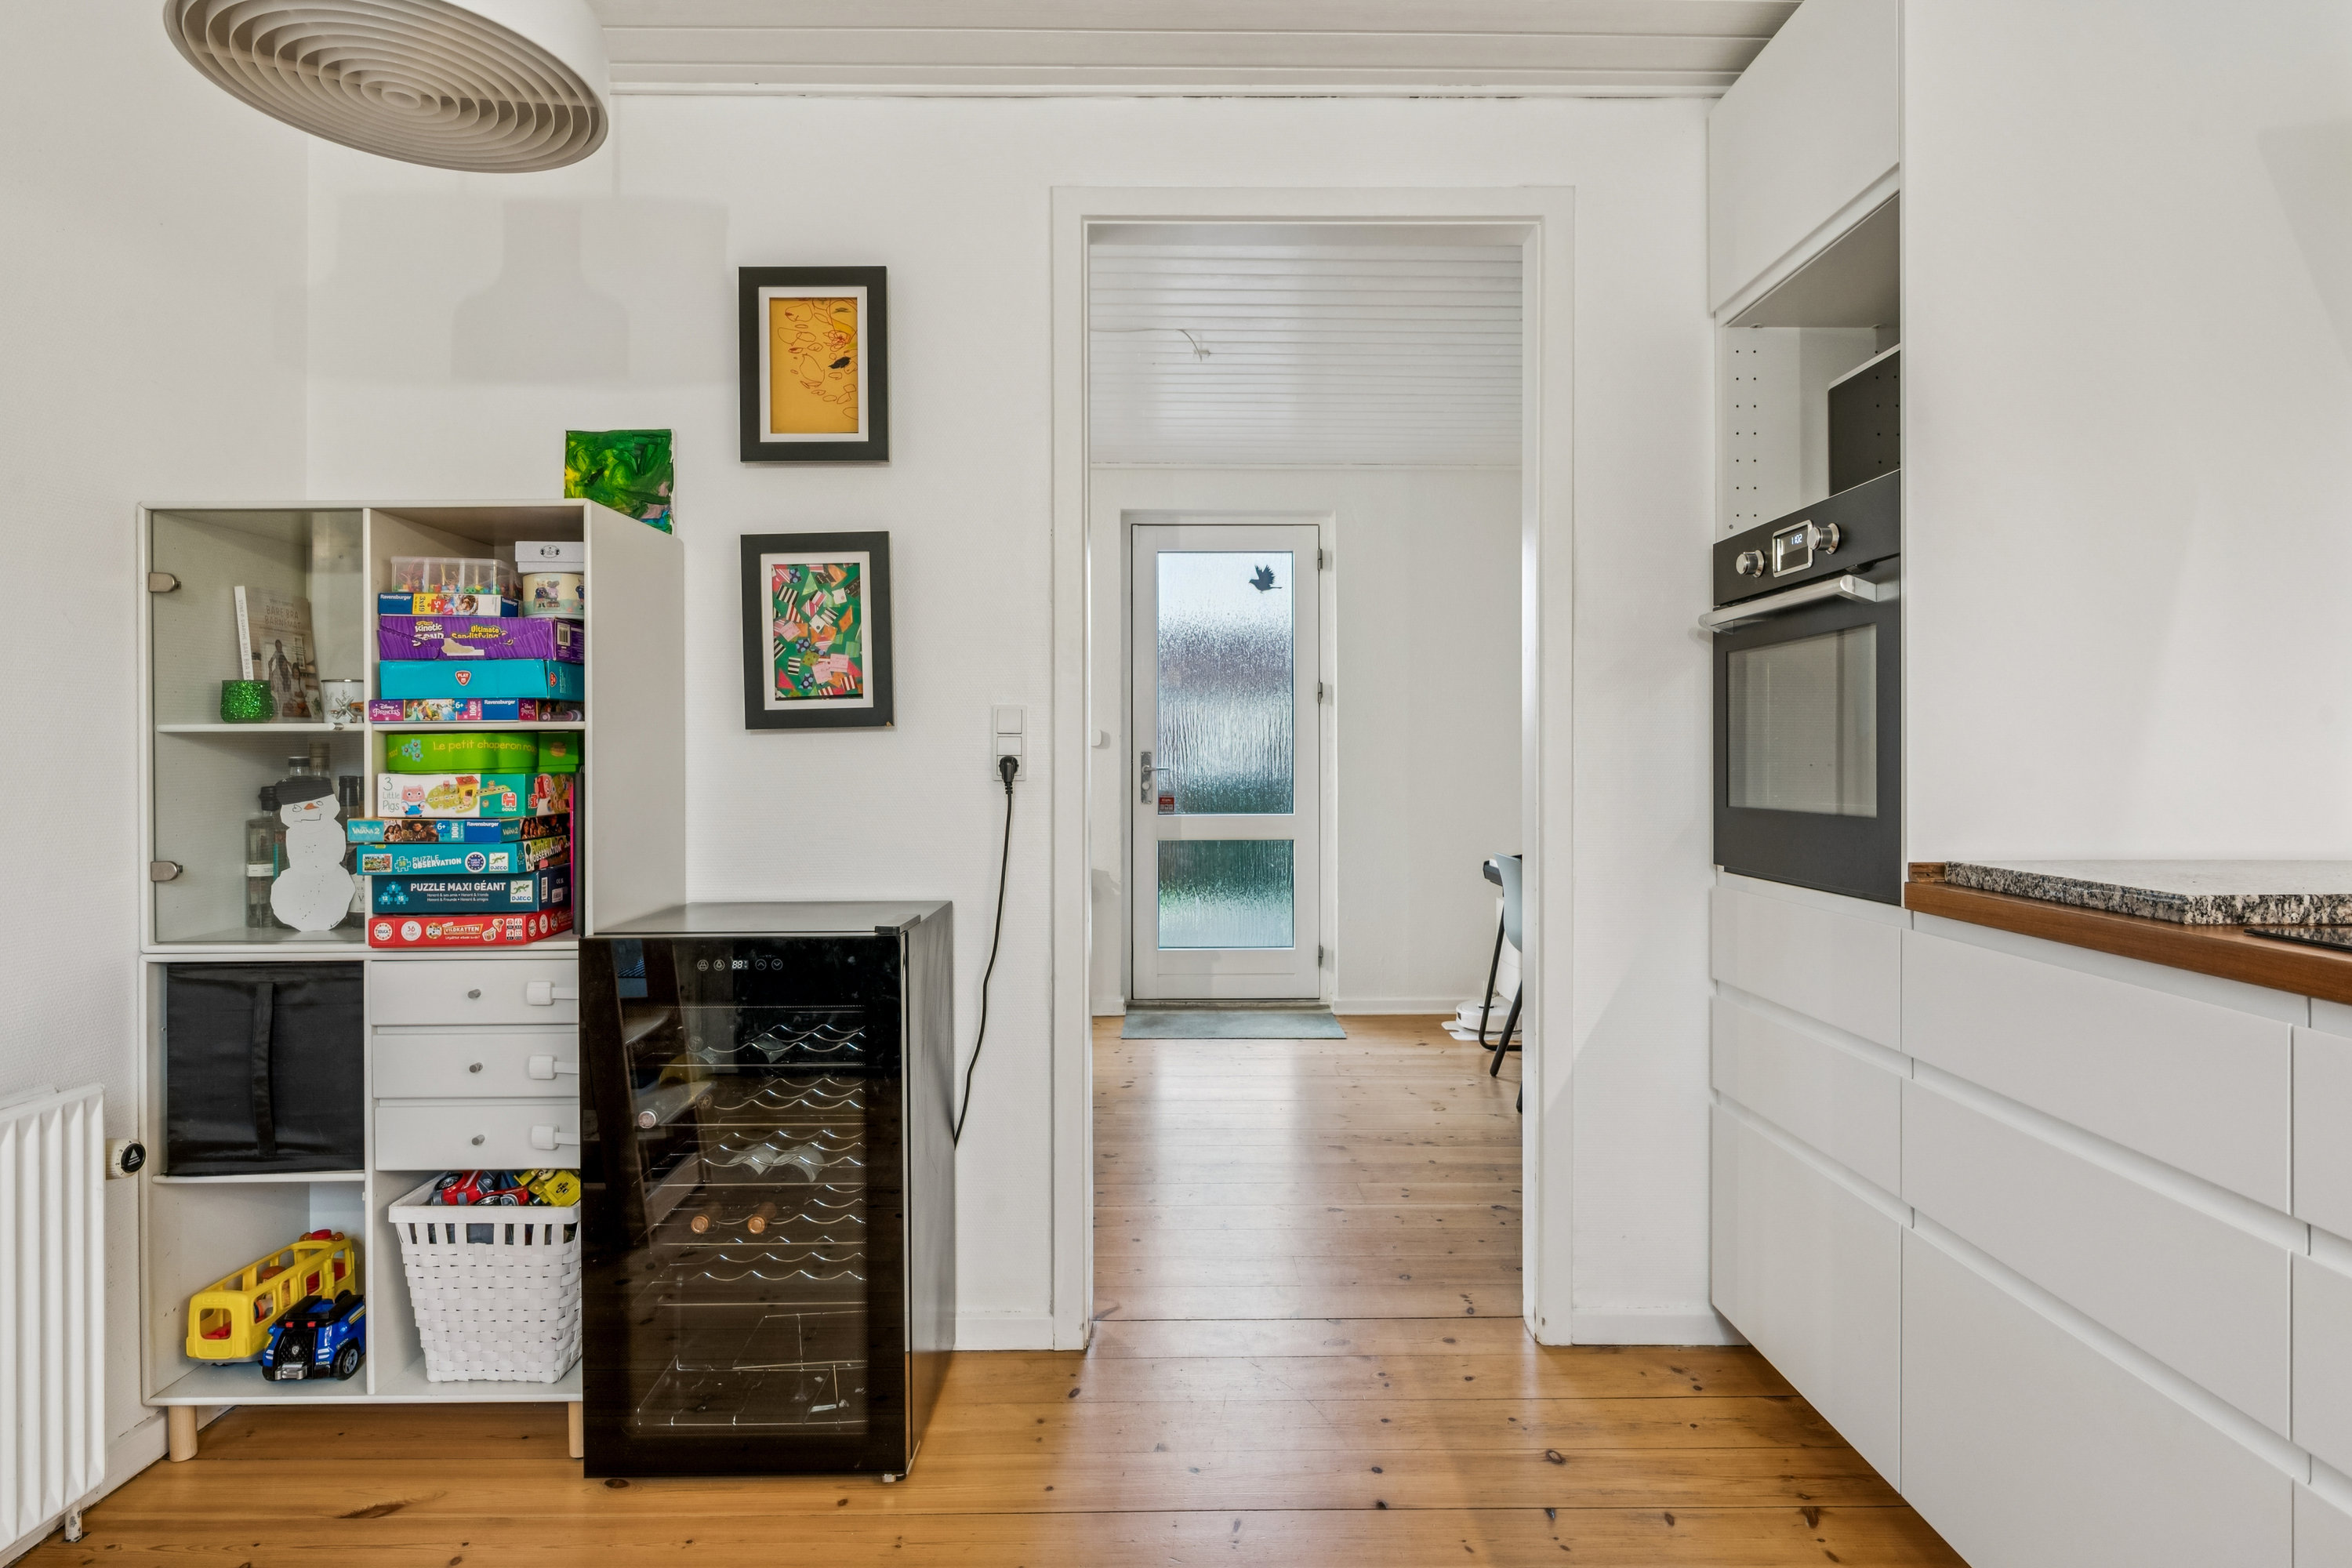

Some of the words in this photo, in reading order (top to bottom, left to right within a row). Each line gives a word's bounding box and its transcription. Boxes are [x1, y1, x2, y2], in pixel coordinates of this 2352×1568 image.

[267, 605, 284, 616] BARE
[285, 609, 299, 619] BRA
[415, 623, 442, 632] Kinetic
[433, 741, 445, 750] Le
[448, 740, 474, 752] petit
[477, 740, 521, 750] chaperon
[383, 777, 393, 790] 3
[383, 800, 399, 812] Pigs
[412, 858, 462, 869] OBSERVATION
[411, 883, 445, 891] PUZZLE
[474, 880, 506, 891] GÉANT
[731, 960, 742, 969] 88
